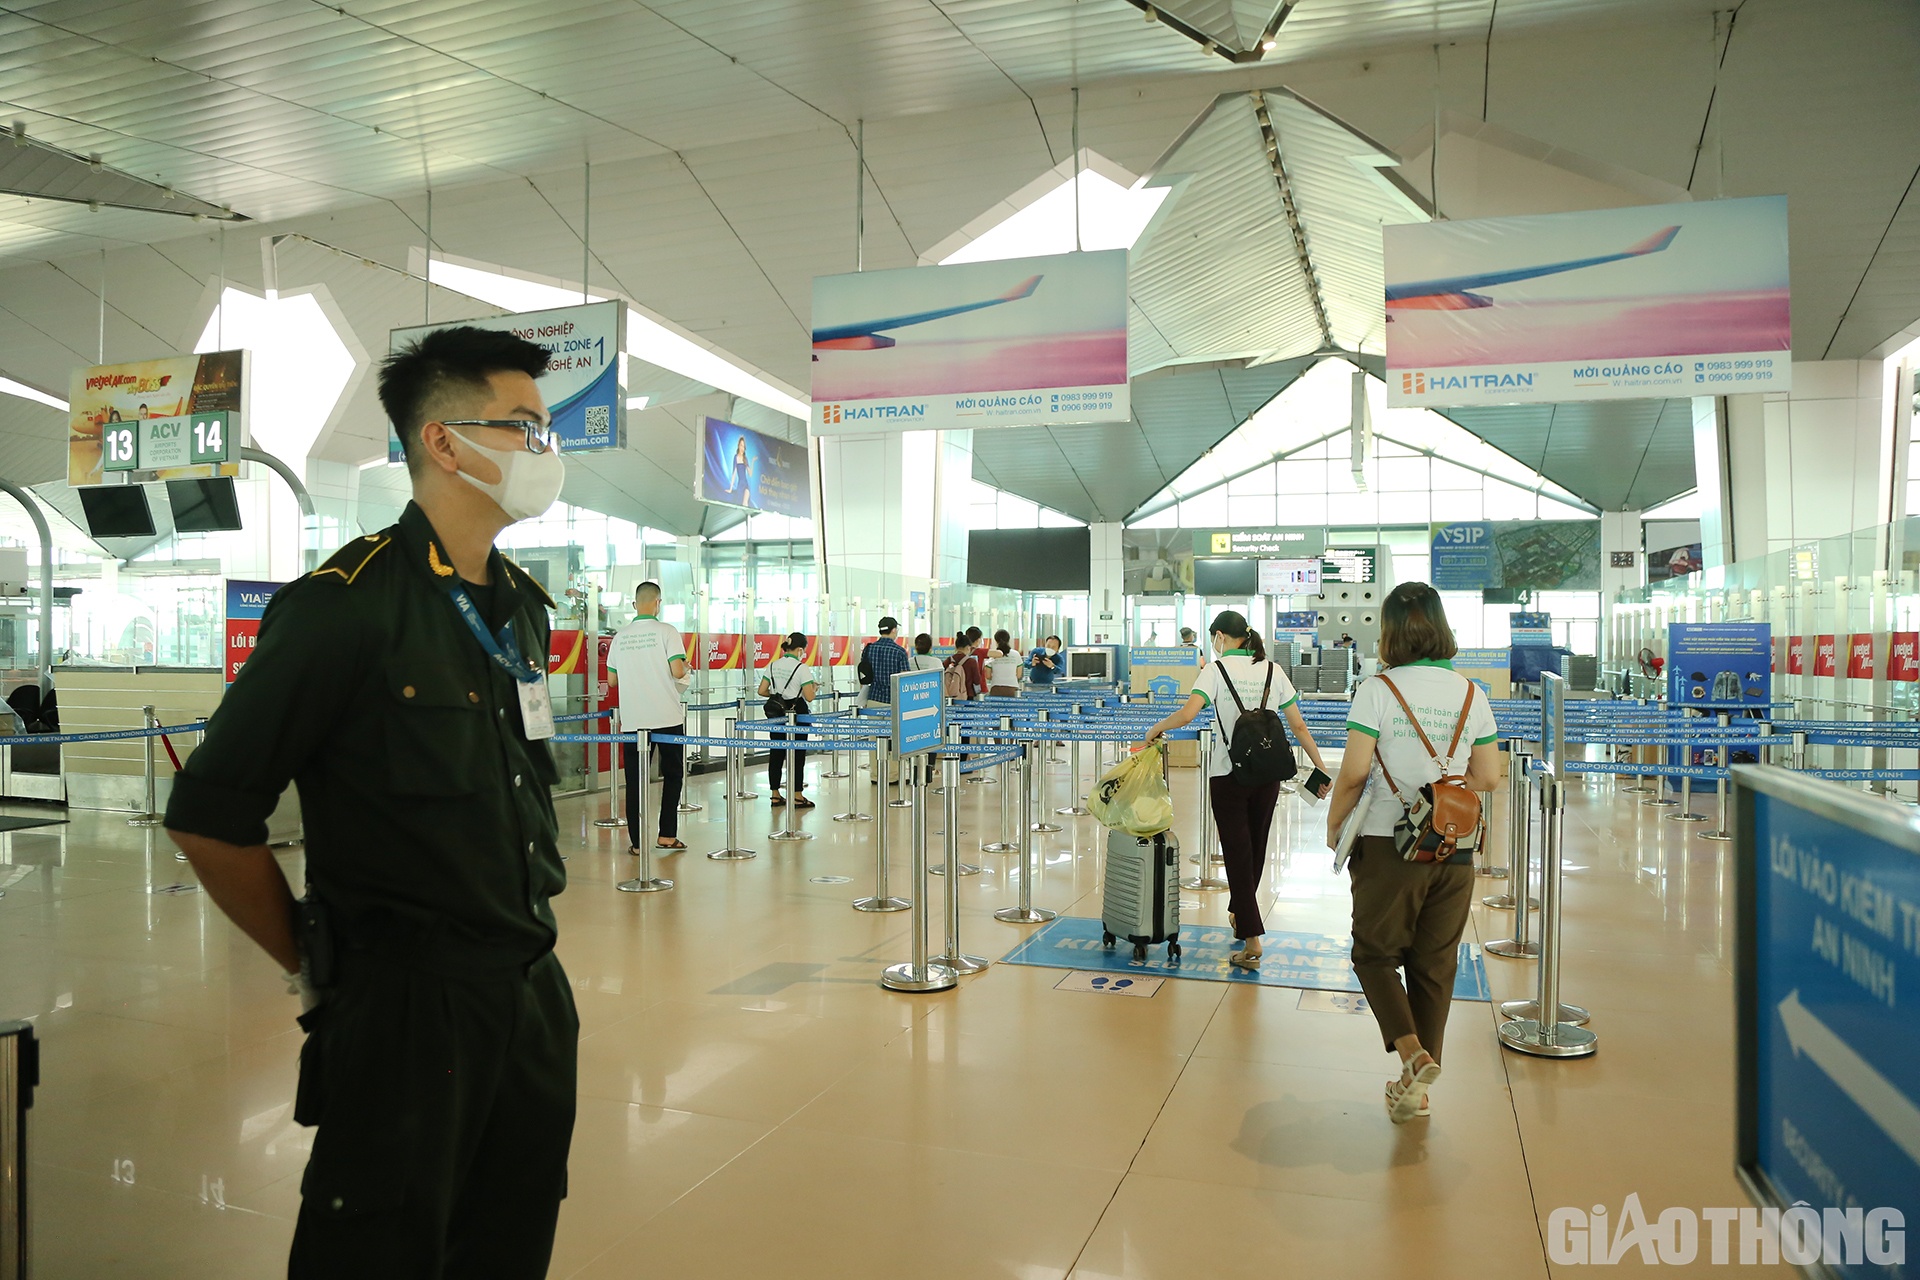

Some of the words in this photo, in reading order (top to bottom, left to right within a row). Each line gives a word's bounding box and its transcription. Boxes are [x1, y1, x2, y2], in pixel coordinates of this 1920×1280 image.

[537, 322, 574, 339] NGHIỆP
[564, 338, 591, 351] ZONE
[594, 336, 604, 366] 1
[576, 356, 591, 367] AN
[1707, 362, 1732, 371] 0983
[1734, 361, 1753, 370] 999
[1756, 359, 1773, 369] 919
[1573, 366, 1599, 378] MỜI
[1602, 363, 1650, 378] QUẢNG
[1654, 361, 1683, 374] CÁO
[1708, 373, 1733, 381] 0906
[1735, 372, 1753, 380] 999
[1756, 371, 1773, 380] 919
[956, 398, 976, 409] MỜI
[979, 396, 1016, 408] QUẢNG
[1019, 394, 1042, 405] CÁO
[1099, 402, 1112, 410] 919
[150, 422, 181, 439] ACV
[194, 420, 222, 454] 14
[107, 429, 133, 461] 13
[154, 441, 177, 449] AIRPORTS
[560, 435, 609, 448] etnam.com
[150, 448, 181, 456] CORPORATION
[1232, 532, 1251, 542] KIỂM
[1252, 532, 1271, 541] SOÁT
[1272, 533, 1283, 541] AN
[1285, 533, 1305, 541] NINH
[1437, 527, 1485, 543] VSIP
[1232, 544, 1258, 553] Security
[240, 593, 262, 603] VIA
[455, 593, 469, 612] VIA
[1518, 590, 1528, 603] 4
[231, 631, 246, 648] LỐI
[493, 653, 513, 668] ACV
[920, 691, 930, 700] NINH
[920, 732, 931, 740] CHECK
[1565, 763, 1638, 771] CORPORATION
[1657, 766, 1703, 774] VIETNAM
[1770, 834, 1796, 882] LỐI
[1799, 845, 1836, 906] VÀO
[1841, 870, 1895, 942] KIỂM
[1128, 959, 1250, 976] SECURITY
[1262, 953, 1323, 968] AN
[1812, 915, 1839, 967] AN
[1843, 932, 1895, 1008] NINH
